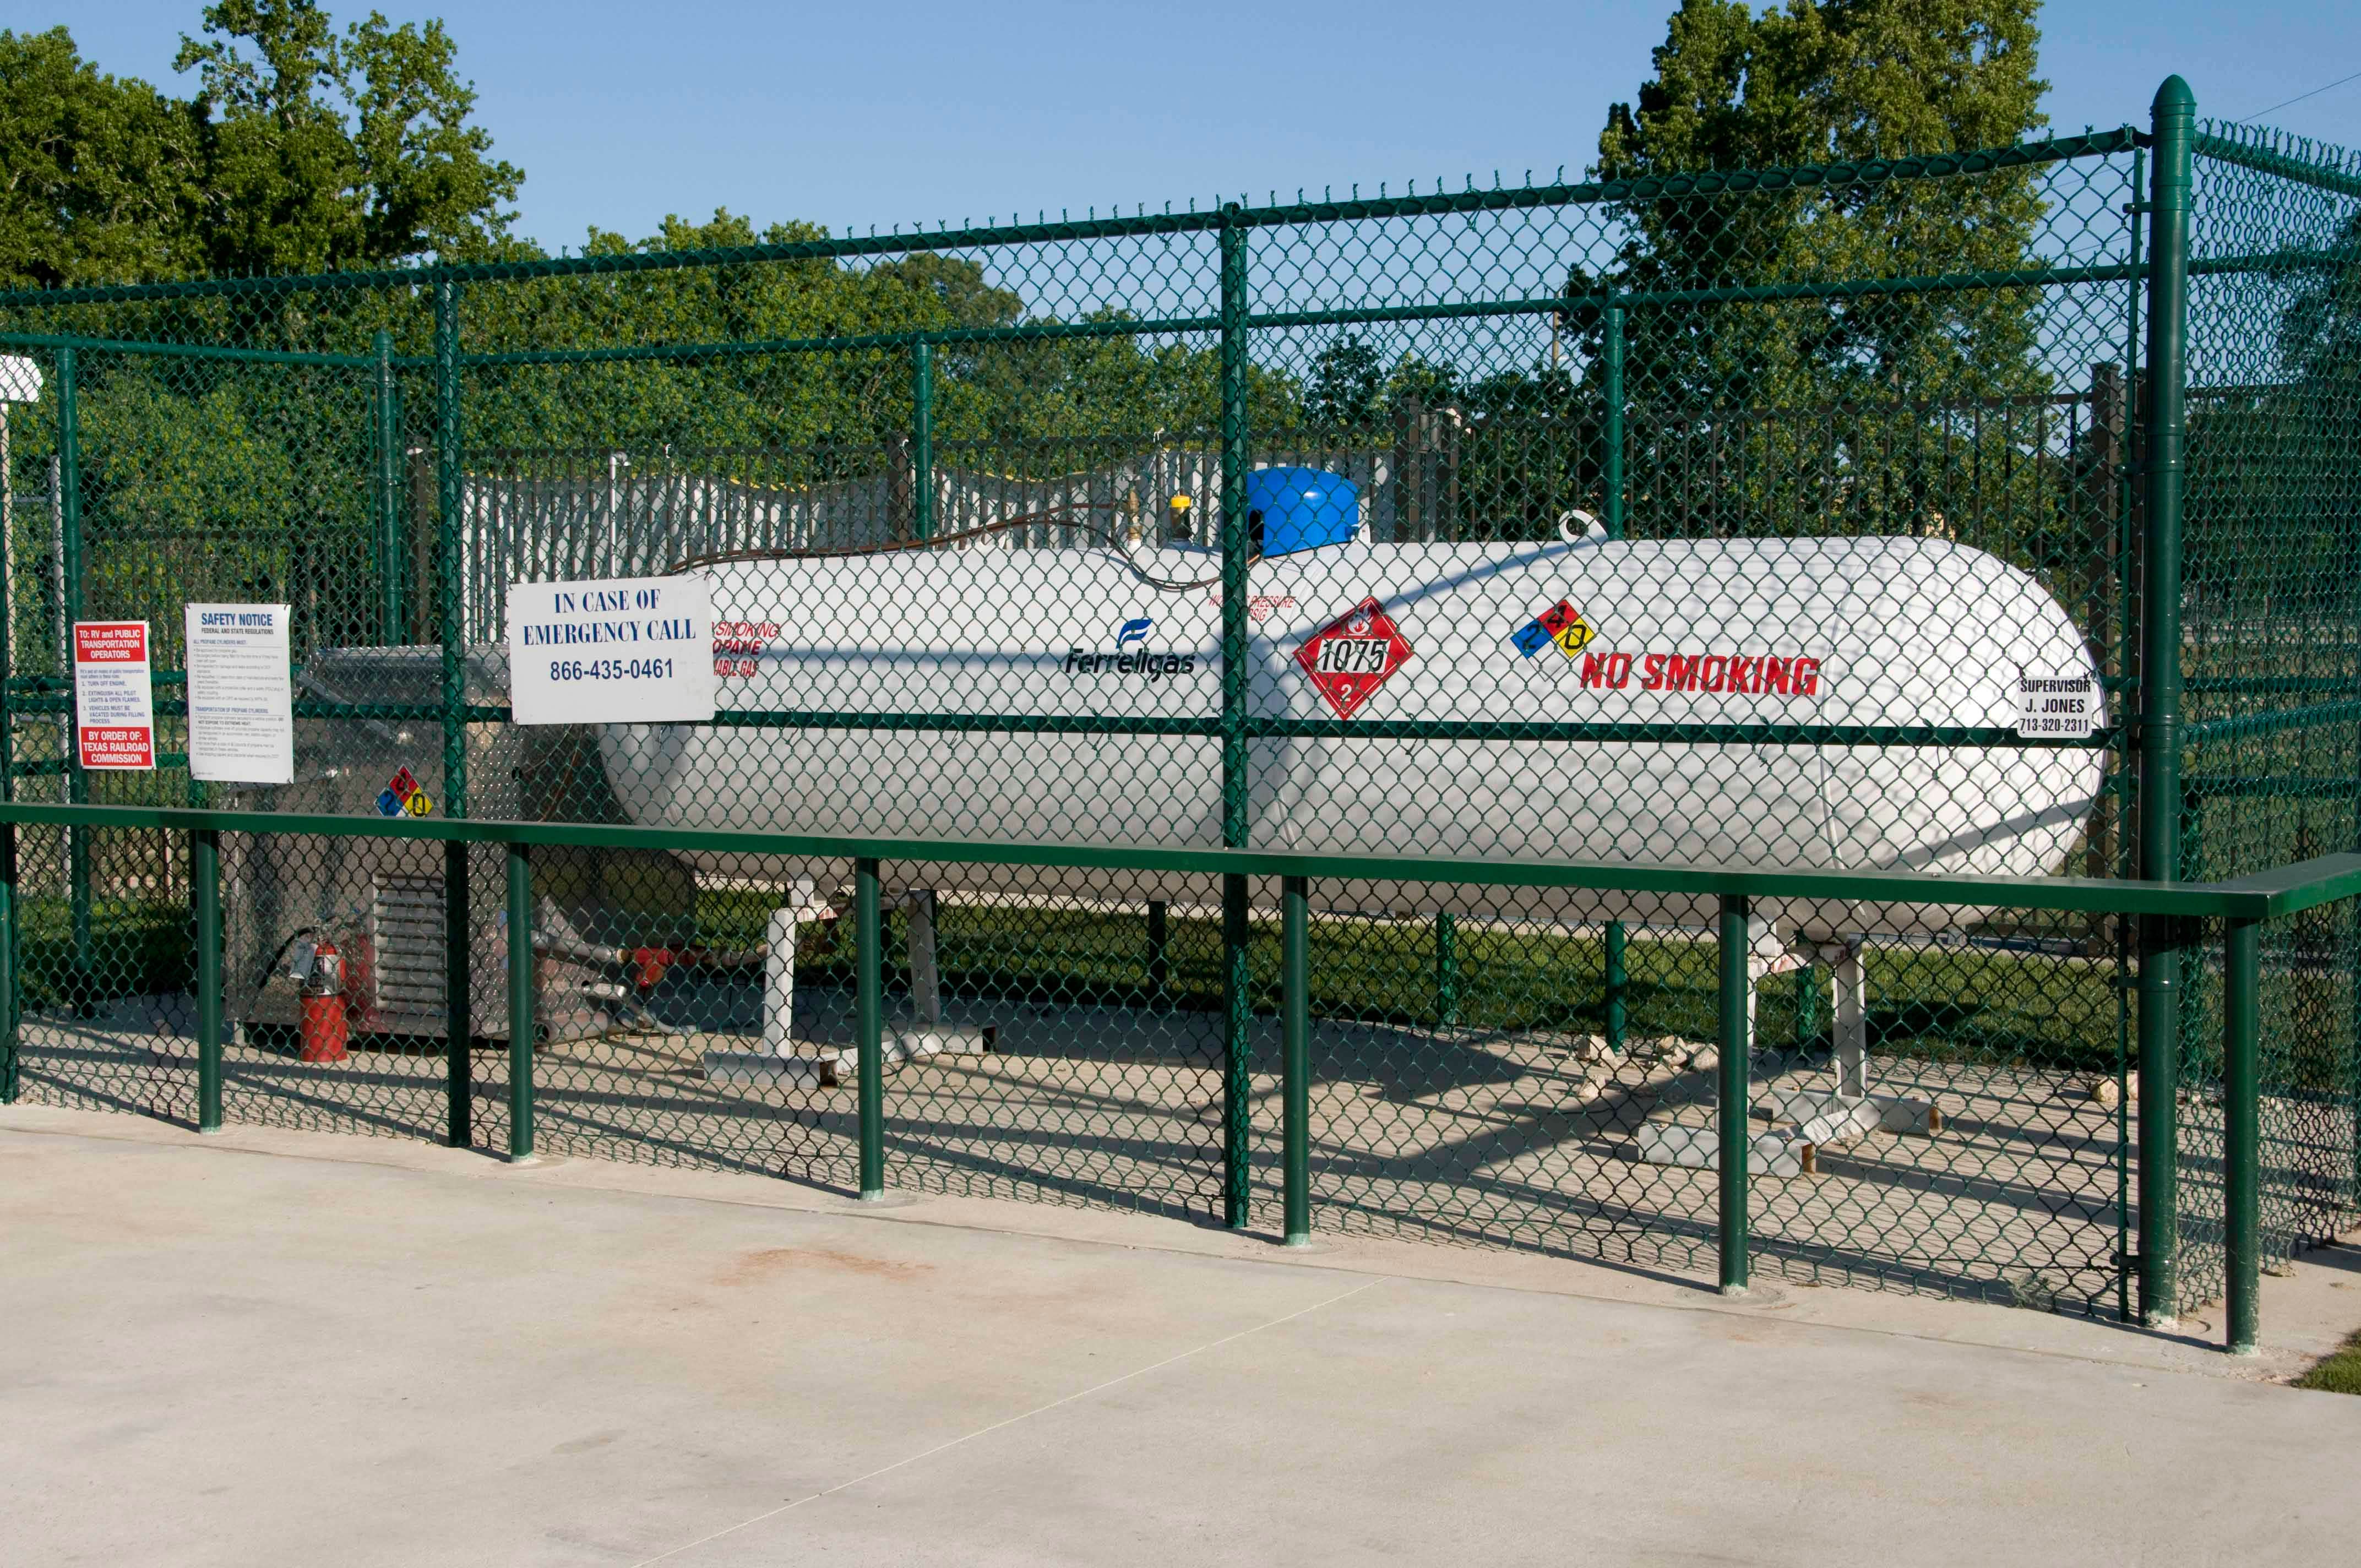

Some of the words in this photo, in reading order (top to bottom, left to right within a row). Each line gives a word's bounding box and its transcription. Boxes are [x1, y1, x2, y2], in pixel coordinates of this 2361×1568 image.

[554, 592, 575, 613] IN
[583, 590, 629, 612] CASE
[637, 589, 661, 609] OF
[1250, 595, 1296, 608] PRESSURE
[202, 613, 236, 625] SAFETY
[239, 613, 273, 626] NOTICE
[79, 630, 89, 638] TO:
[91, 630, 100, 638] RV
[101, 630, 113, 638] and
[115, 629, 141, 638] PUBLIC
[524, 620, 640, 645] EMERGENCY
[647, 618, 696, 641] CALL
[1522, 624, 1541, 649] 2
[81, 640, 140, 649] TRANSPORTATION
[90, 650, 130, 659] OPERATORS
[1323, 640, 1388, 671] 1075
[550, 658, 673, 681] 866-435-0461
[1065, 648, 1196, 683] Ferrellgas
[1580, 652, 1633, 690] NO
[1641, 654, 1820, 696] SMOKING
[1340, 684, 1352, 702] 2
[2020, 679, 2091, 693] SUPERVISOR
[2025, 699, 2037, 712] J.
[2042, 699, 2085, 713] JONES
[2020, 718, 2088, 732] 713-320-2311
[88, 731, 99, 741] BY
[101, 731, 128, 741] ORDER
[129, 731, 142, 741] OF:
[83, 742, 108, 752] TEXAS
[110, 743, 149, 752] RAILROAD
[91, 754, 142, 763] COMMISSION
